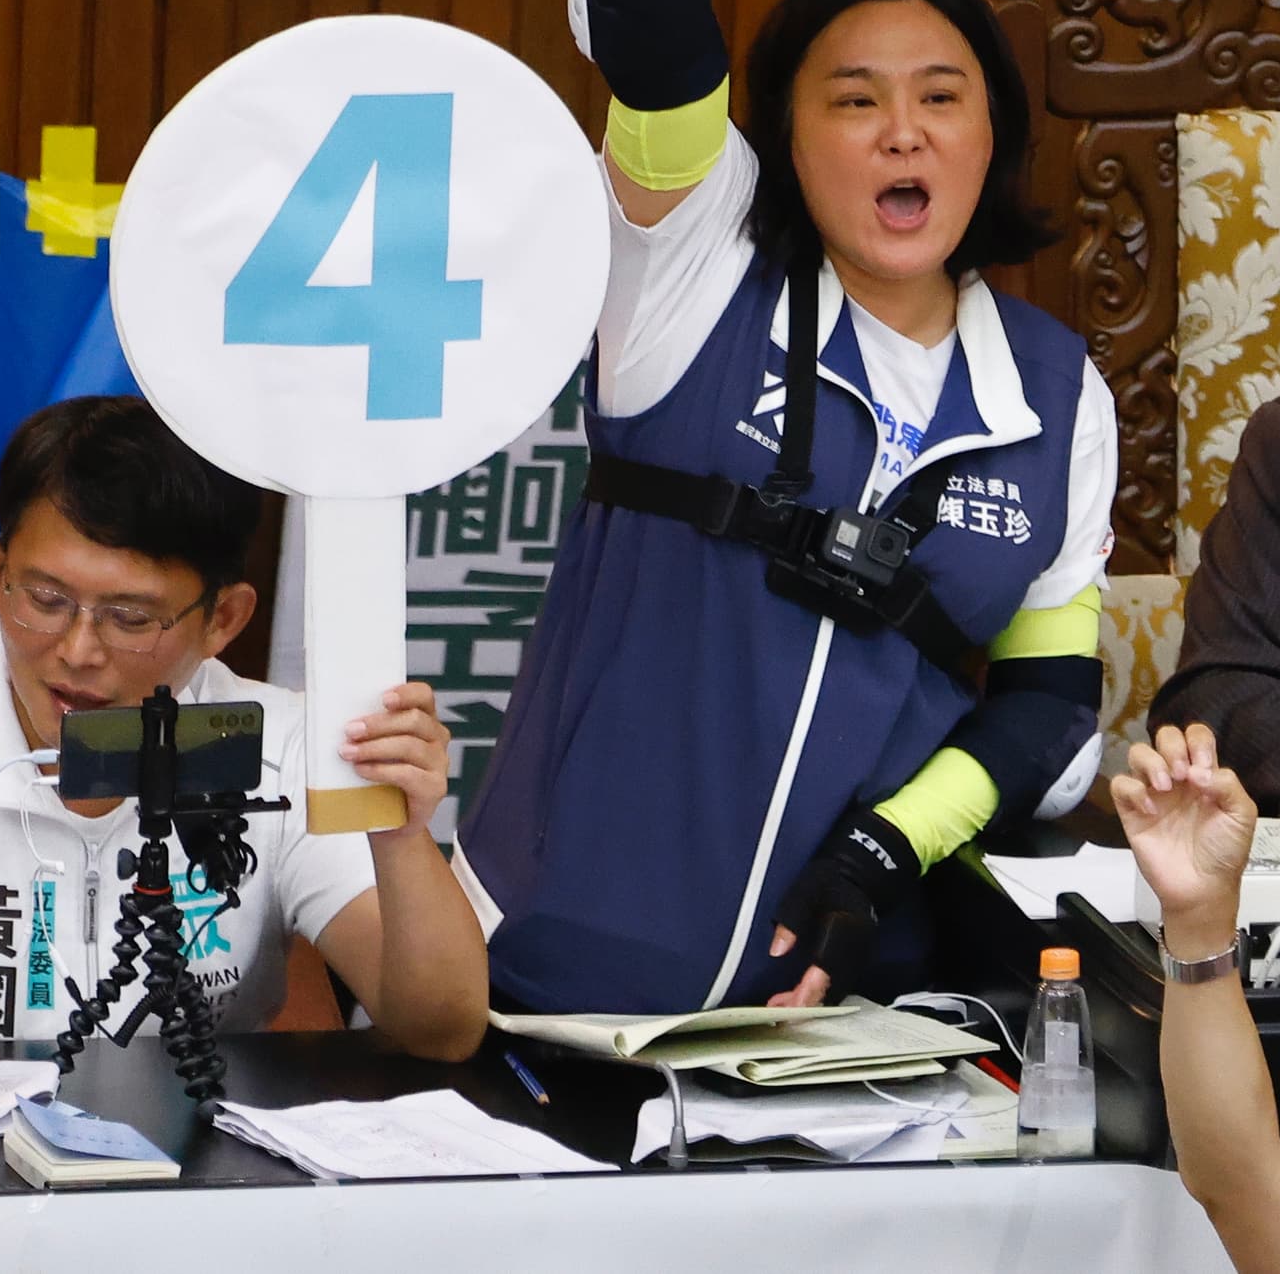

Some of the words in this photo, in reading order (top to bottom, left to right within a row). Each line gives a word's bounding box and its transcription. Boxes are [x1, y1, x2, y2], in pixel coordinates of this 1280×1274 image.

[223, 92, 483, 420] 4
[936, 493, 1033, 545] 陳玉珍
[946, 474, 1023, 504] 立法委員
[29, 889, 54, 1008] 立法委員
